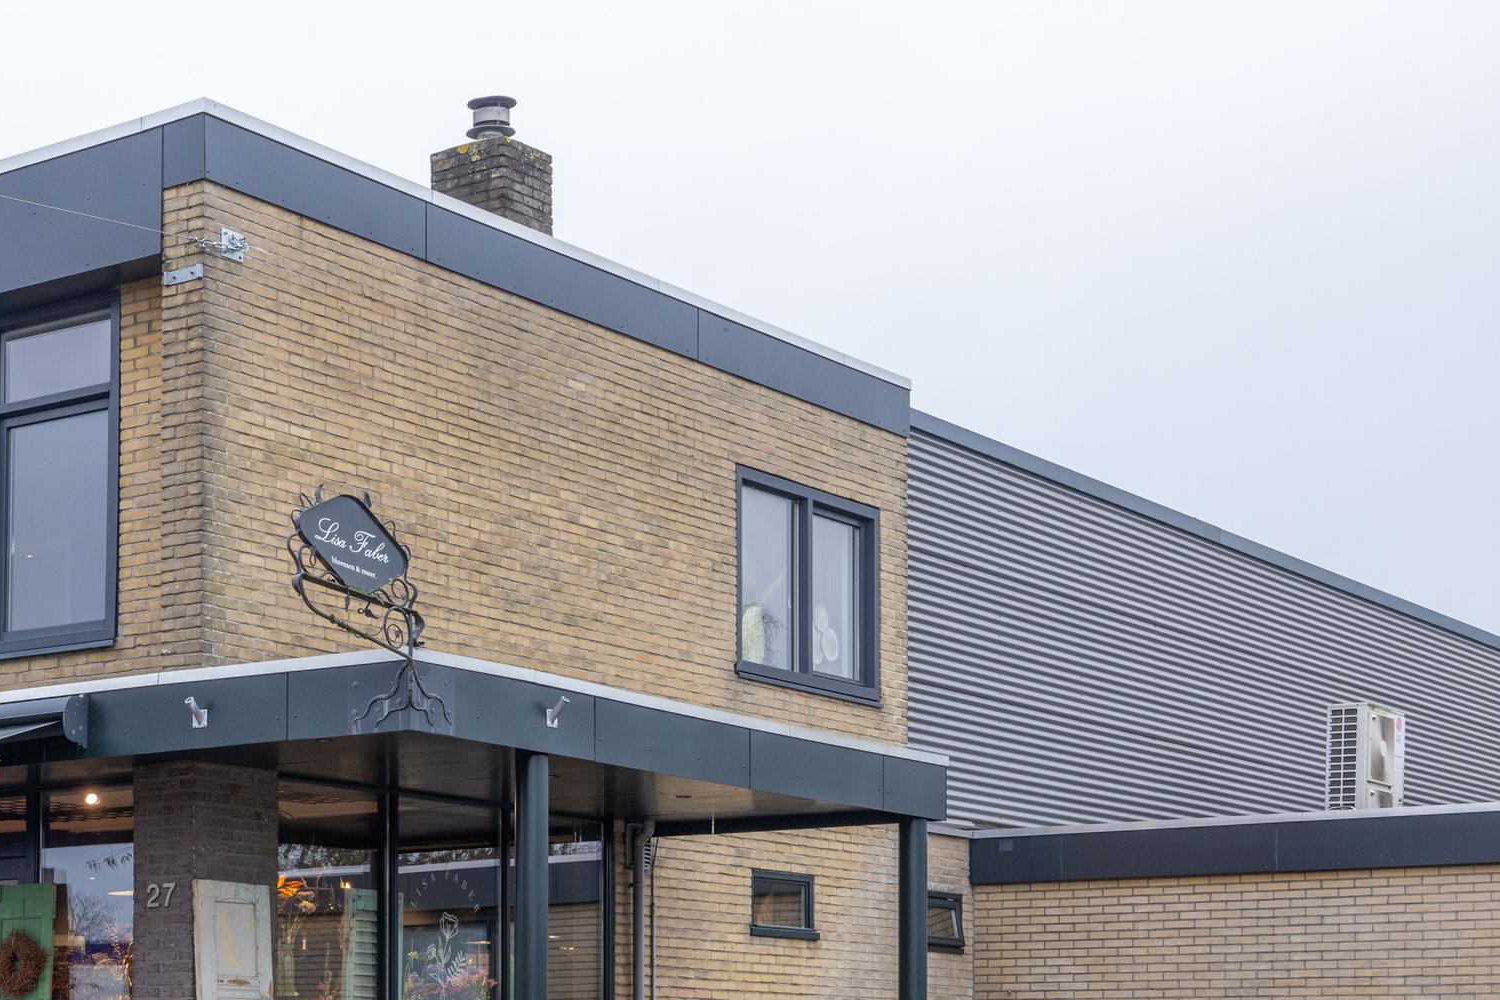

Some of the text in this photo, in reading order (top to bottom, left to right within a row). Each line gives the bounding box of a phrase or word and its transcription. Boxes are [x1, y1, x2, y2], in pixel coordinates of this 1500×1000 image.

[314, 517, 390, 564] Lisa Faber
[146, 883, 176, 908] 27
